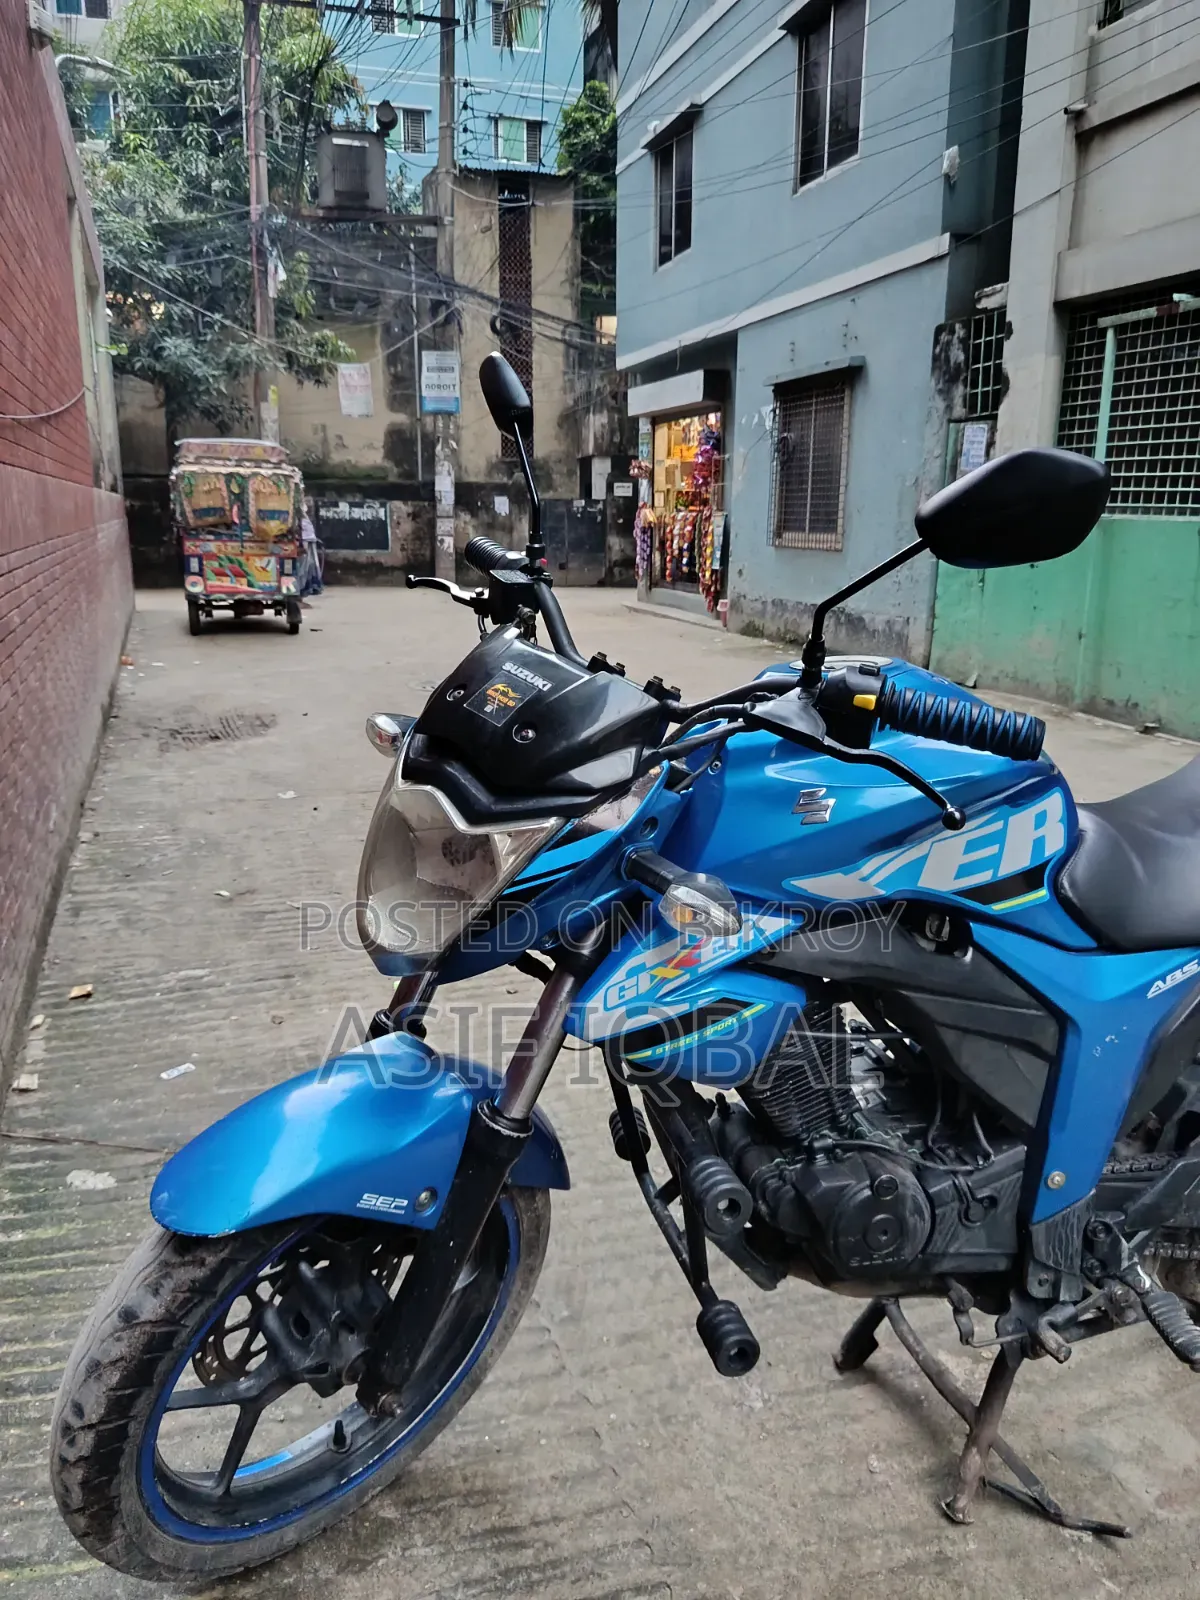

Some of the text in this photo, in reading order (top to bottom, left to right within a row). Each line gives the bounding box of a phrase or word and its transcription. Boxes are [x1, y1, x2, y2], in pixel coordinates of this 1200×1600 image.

[502, 662, 552, 691] SUZUKI
[1146, 958, 1200, 999] ABS
[655, 1016, 739, 1055] STREET SPORT
[360, 1193, 408, 1208] SEP
